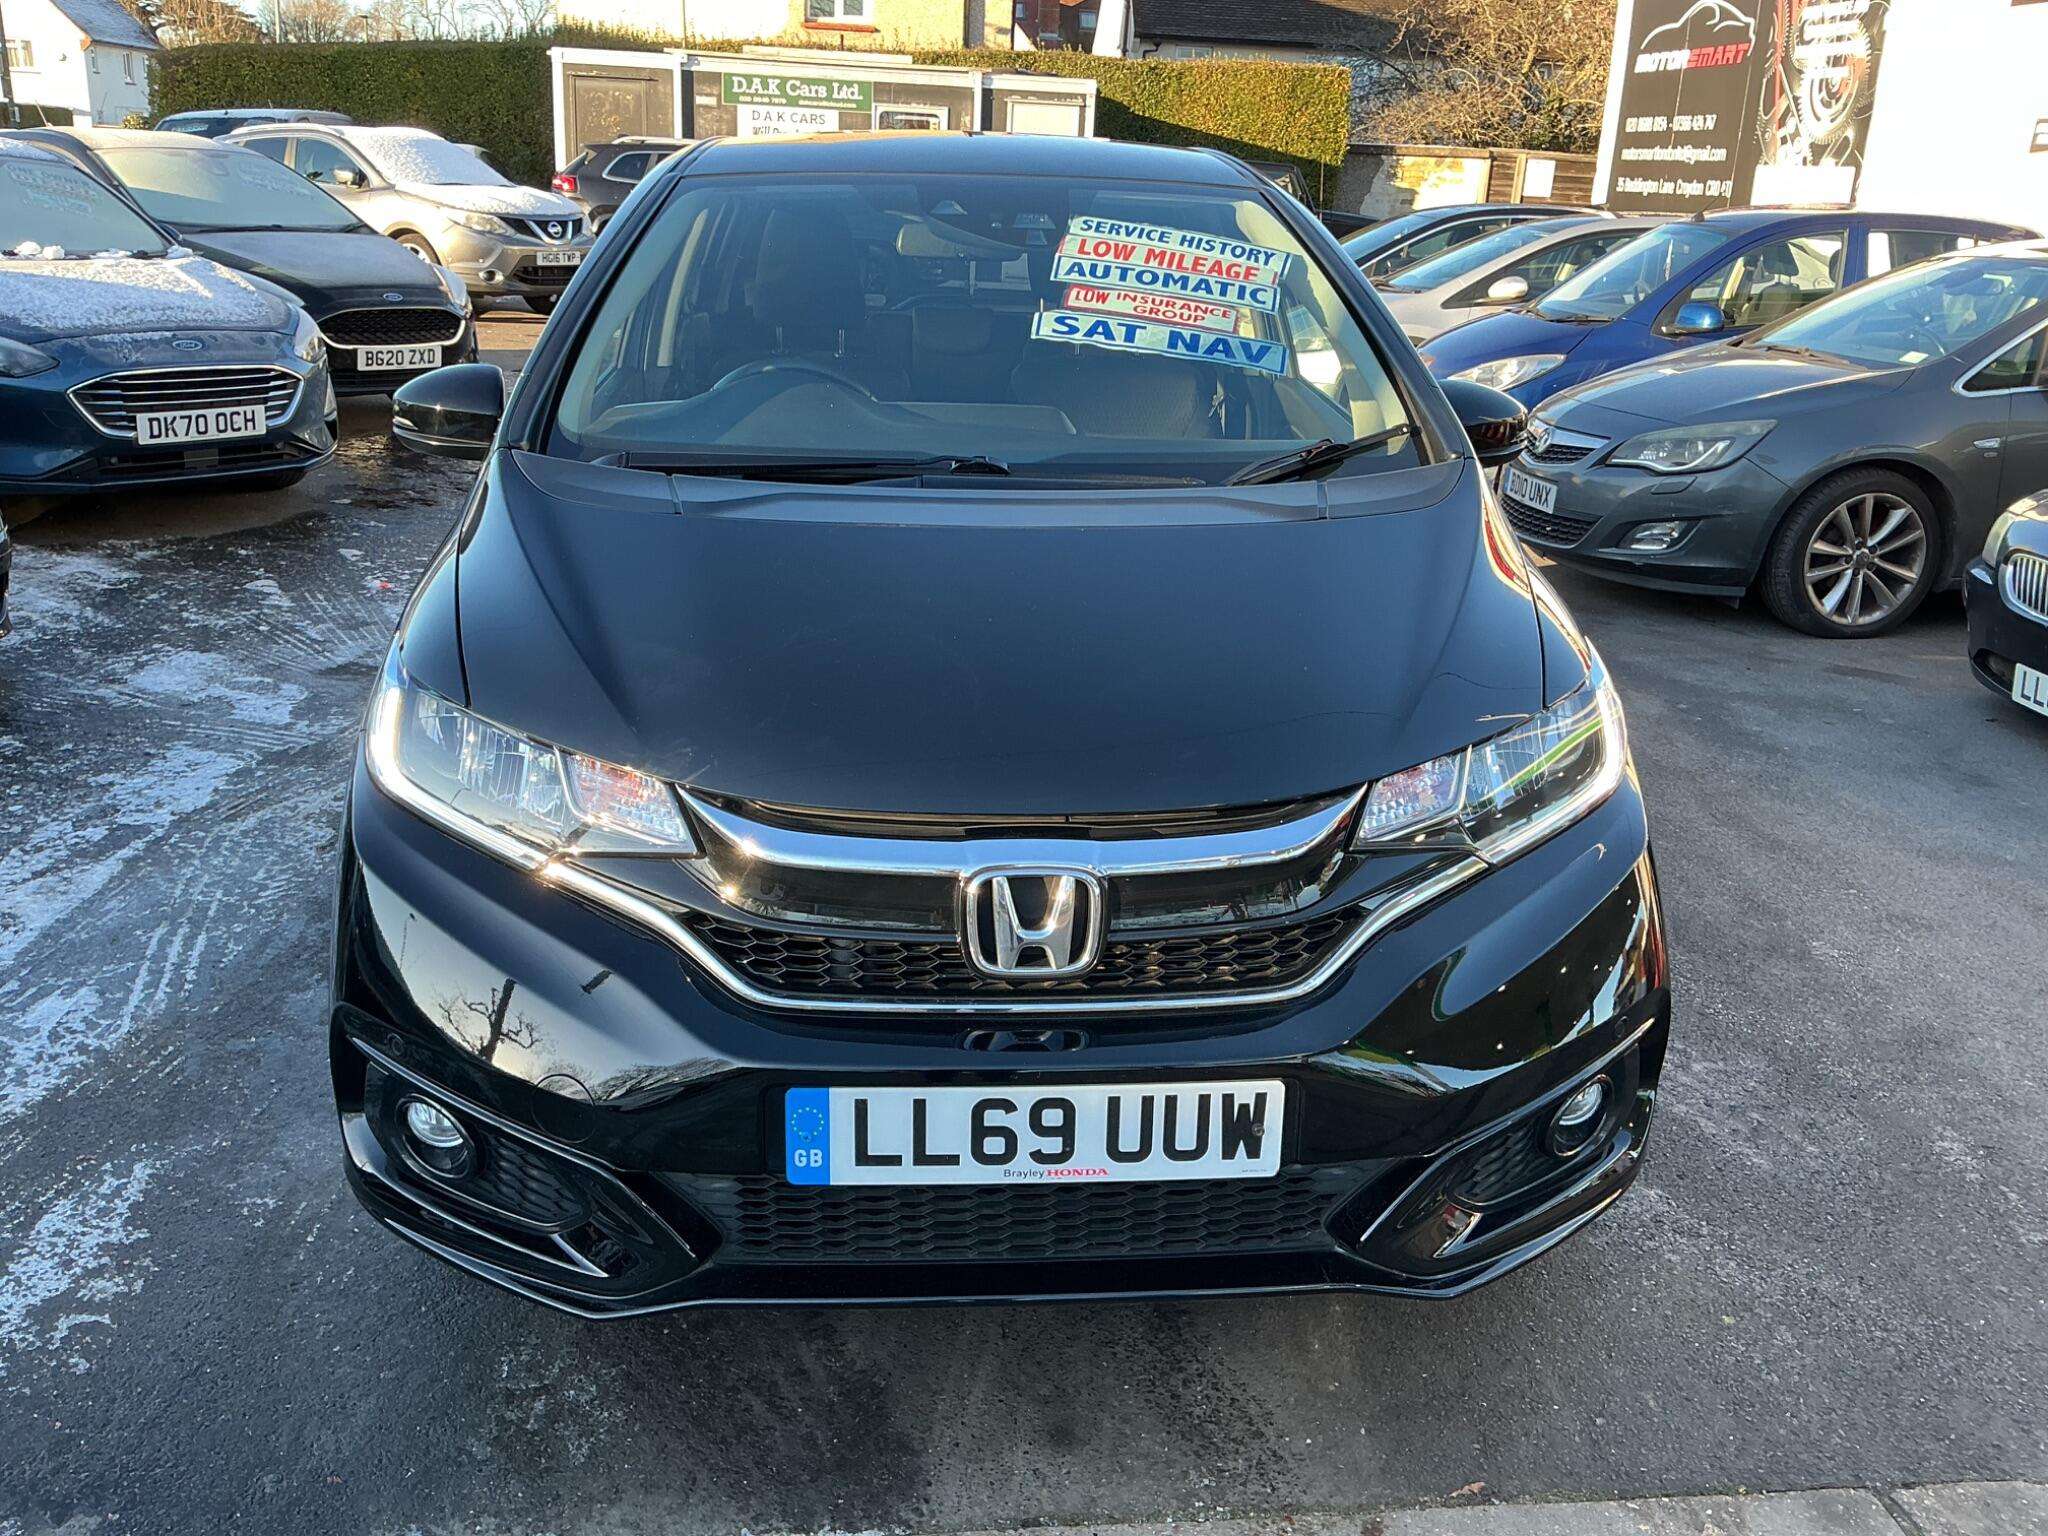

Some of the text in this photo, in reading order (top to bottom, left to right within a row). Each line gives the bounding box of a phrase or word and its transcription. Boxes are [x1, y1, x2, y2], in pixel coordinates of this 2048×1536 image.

[732, 76, 863, 100] D.A.K Cars Ltd.
[790, 112, 826, 125] CARS
[1080, 219, 1276, 267] SERVICE HISTORY
[1077, 238, 1260, 281] LOW MILEAGE
[1063, 260, 1270, 305] AUTOMATIC
[1074, 290, 1231, 319] LOW INSURANCE
[1132, 305, 1206, 324] GROUP
[1050, 315, 1273, 364] SAT NAV
[365, 348, 435, 367] BG20 ZXD
[147, 409, 256, 439] DK70 OCH
[1529, 480, 1551, 508] UNX
[853, 1092, 1267, 1167] LL69 UUW
[794, 1149, 823, 1168] GB
[1004, 1168, 1108, 1179] Brayley HONDA
